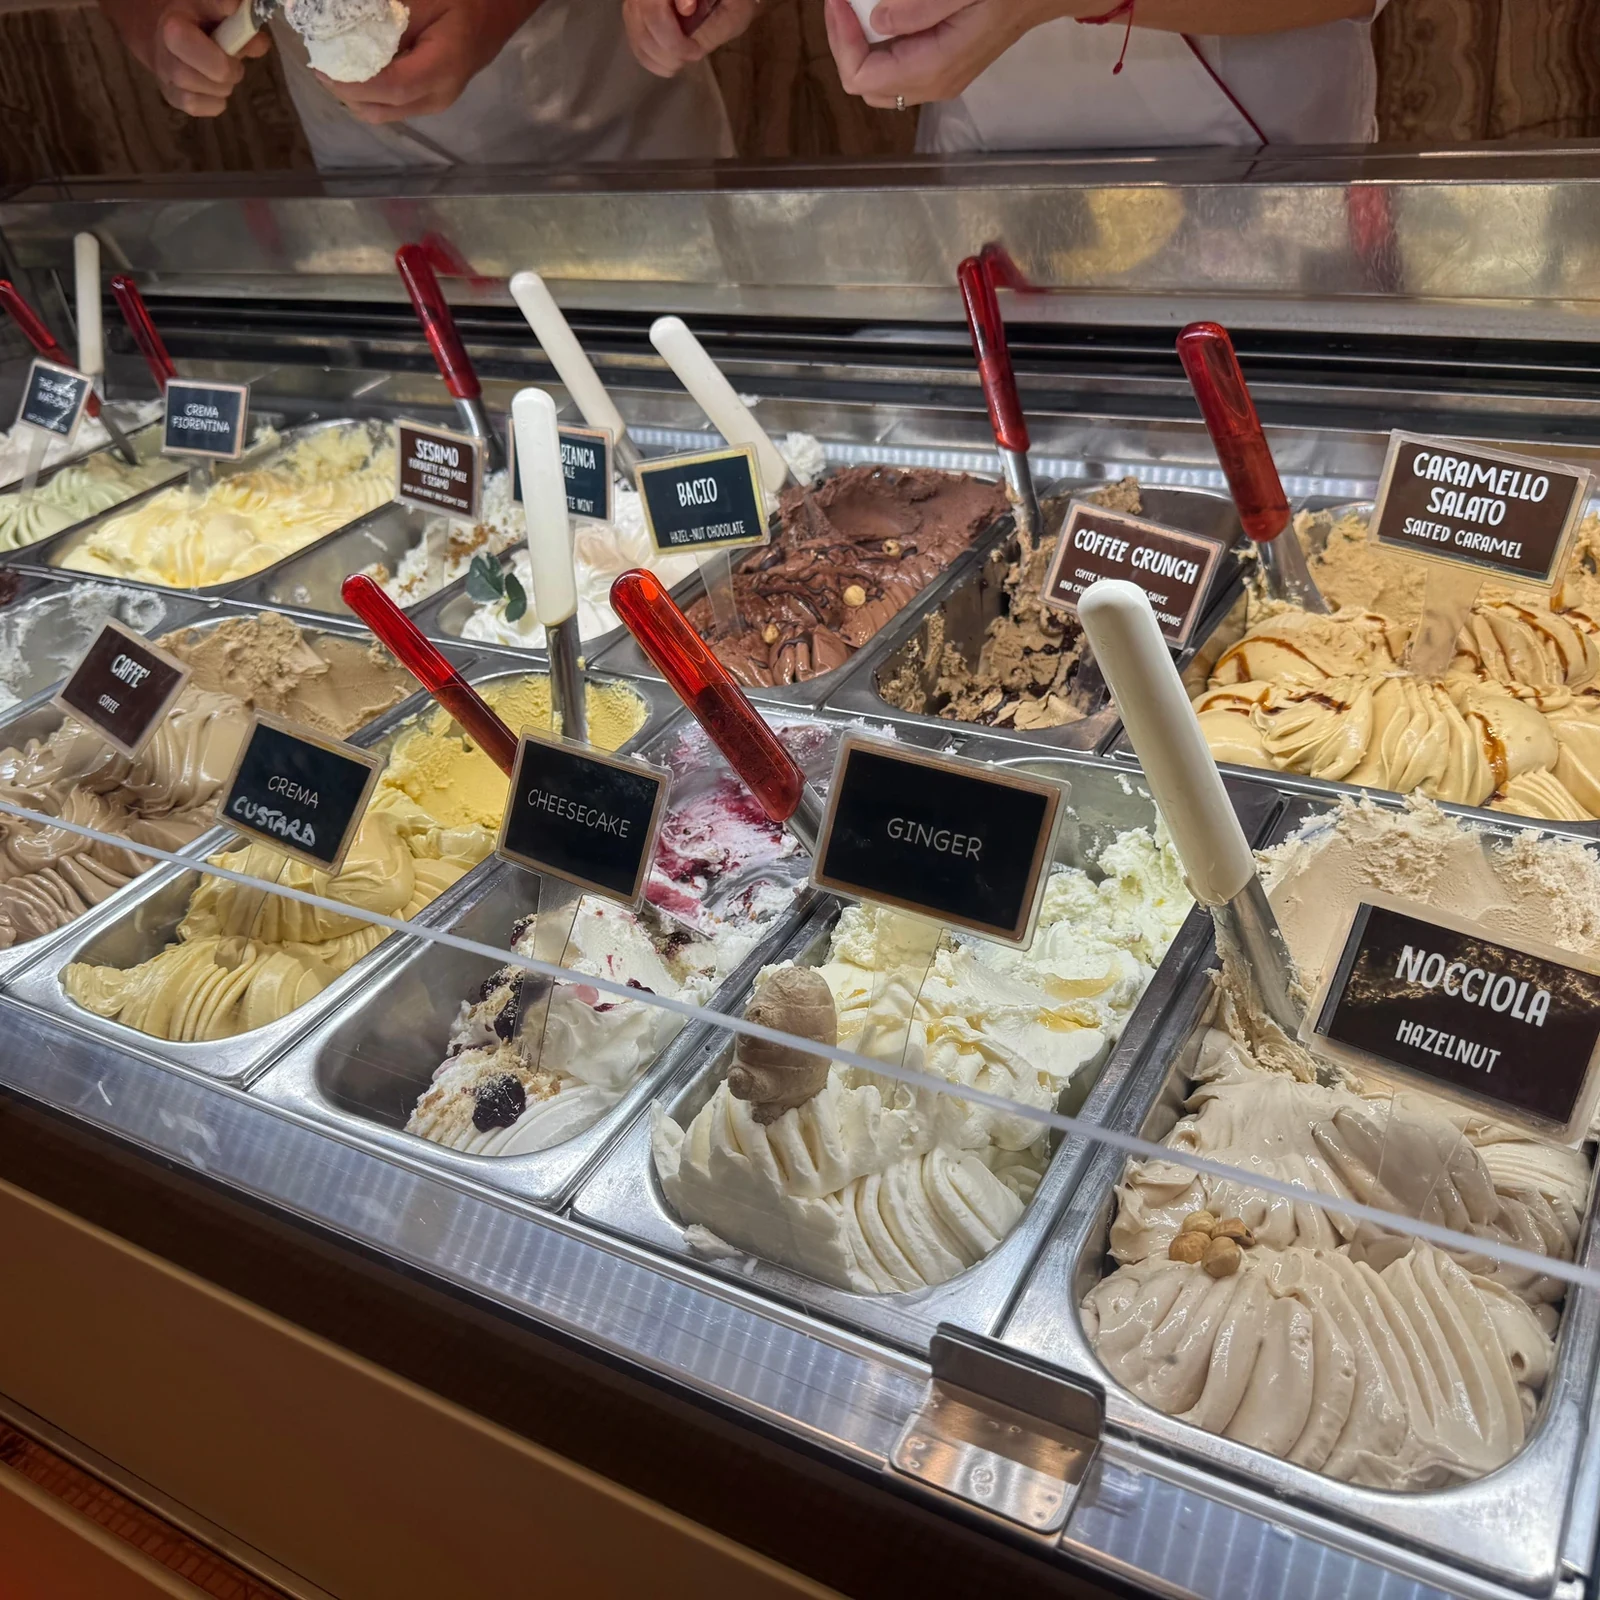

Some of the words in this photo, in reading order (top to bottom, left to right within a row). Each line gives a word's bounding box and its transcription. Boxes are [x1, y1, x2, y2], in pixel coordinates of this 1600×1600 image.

[172, 416, 230, 433] FIORENTINA
[185, 403, 219, 418] CREMA
[415, 438, 459, 467] SESAMO
[676, 477, 718, 507] BACIO
[1413, 452, 1549, 503] CARAMELLO
[577, 498, 594, 513] MINT
[1426, 487, 1507, 526] SALATO
[669, 527, 705, 543] HAZEL-NUT
[706, 521, 745, 539] CHOCOLATE
[1402, 517, 1451, 542] SALTED
[1454, 529, 1523, 560] CARAMEL
[1074, 529, 1130, 563] COFFEE
[1131, 546, 1199, 585] CRUNCH
[1059, 580, 1072, 591] AND
[1075, 568, 1098, 583] COFFEE
[1148, 590, 1168, 606] SAUCE
[98, 694, 120, 714] COFFEE
[267, 775, 319, 809] CREMA
[233, 795, 316, 847] CUSTARD
[527, 788, 631, 839] CHEESECAKE
[887, 817, 983, 862] GINGER
[1395, 944, 1551, 1027] NOCCIOLA
[1396, 1019, 1501, 1073] HAZELNUT
